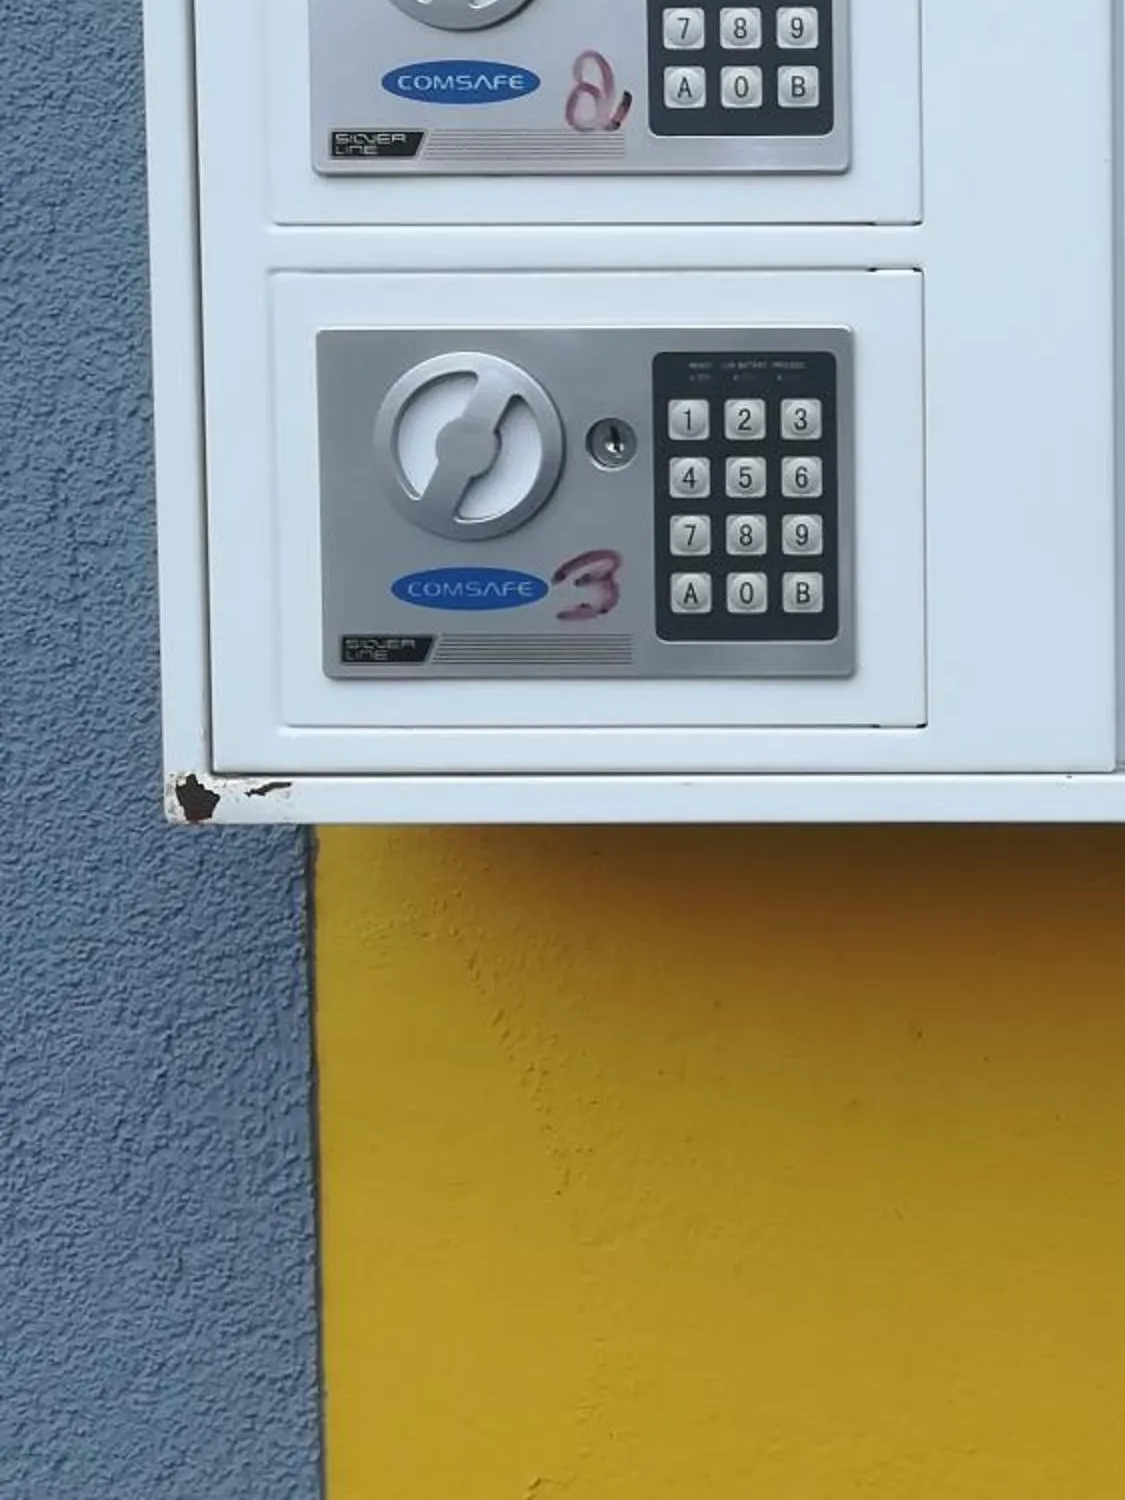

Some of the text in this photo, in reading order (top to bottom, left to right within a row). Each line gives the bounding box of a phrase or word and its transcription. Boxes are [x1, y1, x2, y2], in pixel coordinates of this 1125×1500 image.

[678, 18, 804, 39] 7 8 9
[397, 75, 524, 91] COMSAFE
[566, 50, 632, 132] 2
[678, 76, 805, 98] A 0 B
[335, 134, 406, 144] SILVER
[738, 409, 752, 430] 2
[795, 408, 807, 430] 3
[683, 467, 808, 488] 4 5 6
[684, 524, 808, 546] 7 8 9
[408, 581, 534, 597] COMSAFE
[552, 549, 621, 621] 3
[684, 582, 810, 604] A 0 B
[346, 639, 415, 648] SILVER
